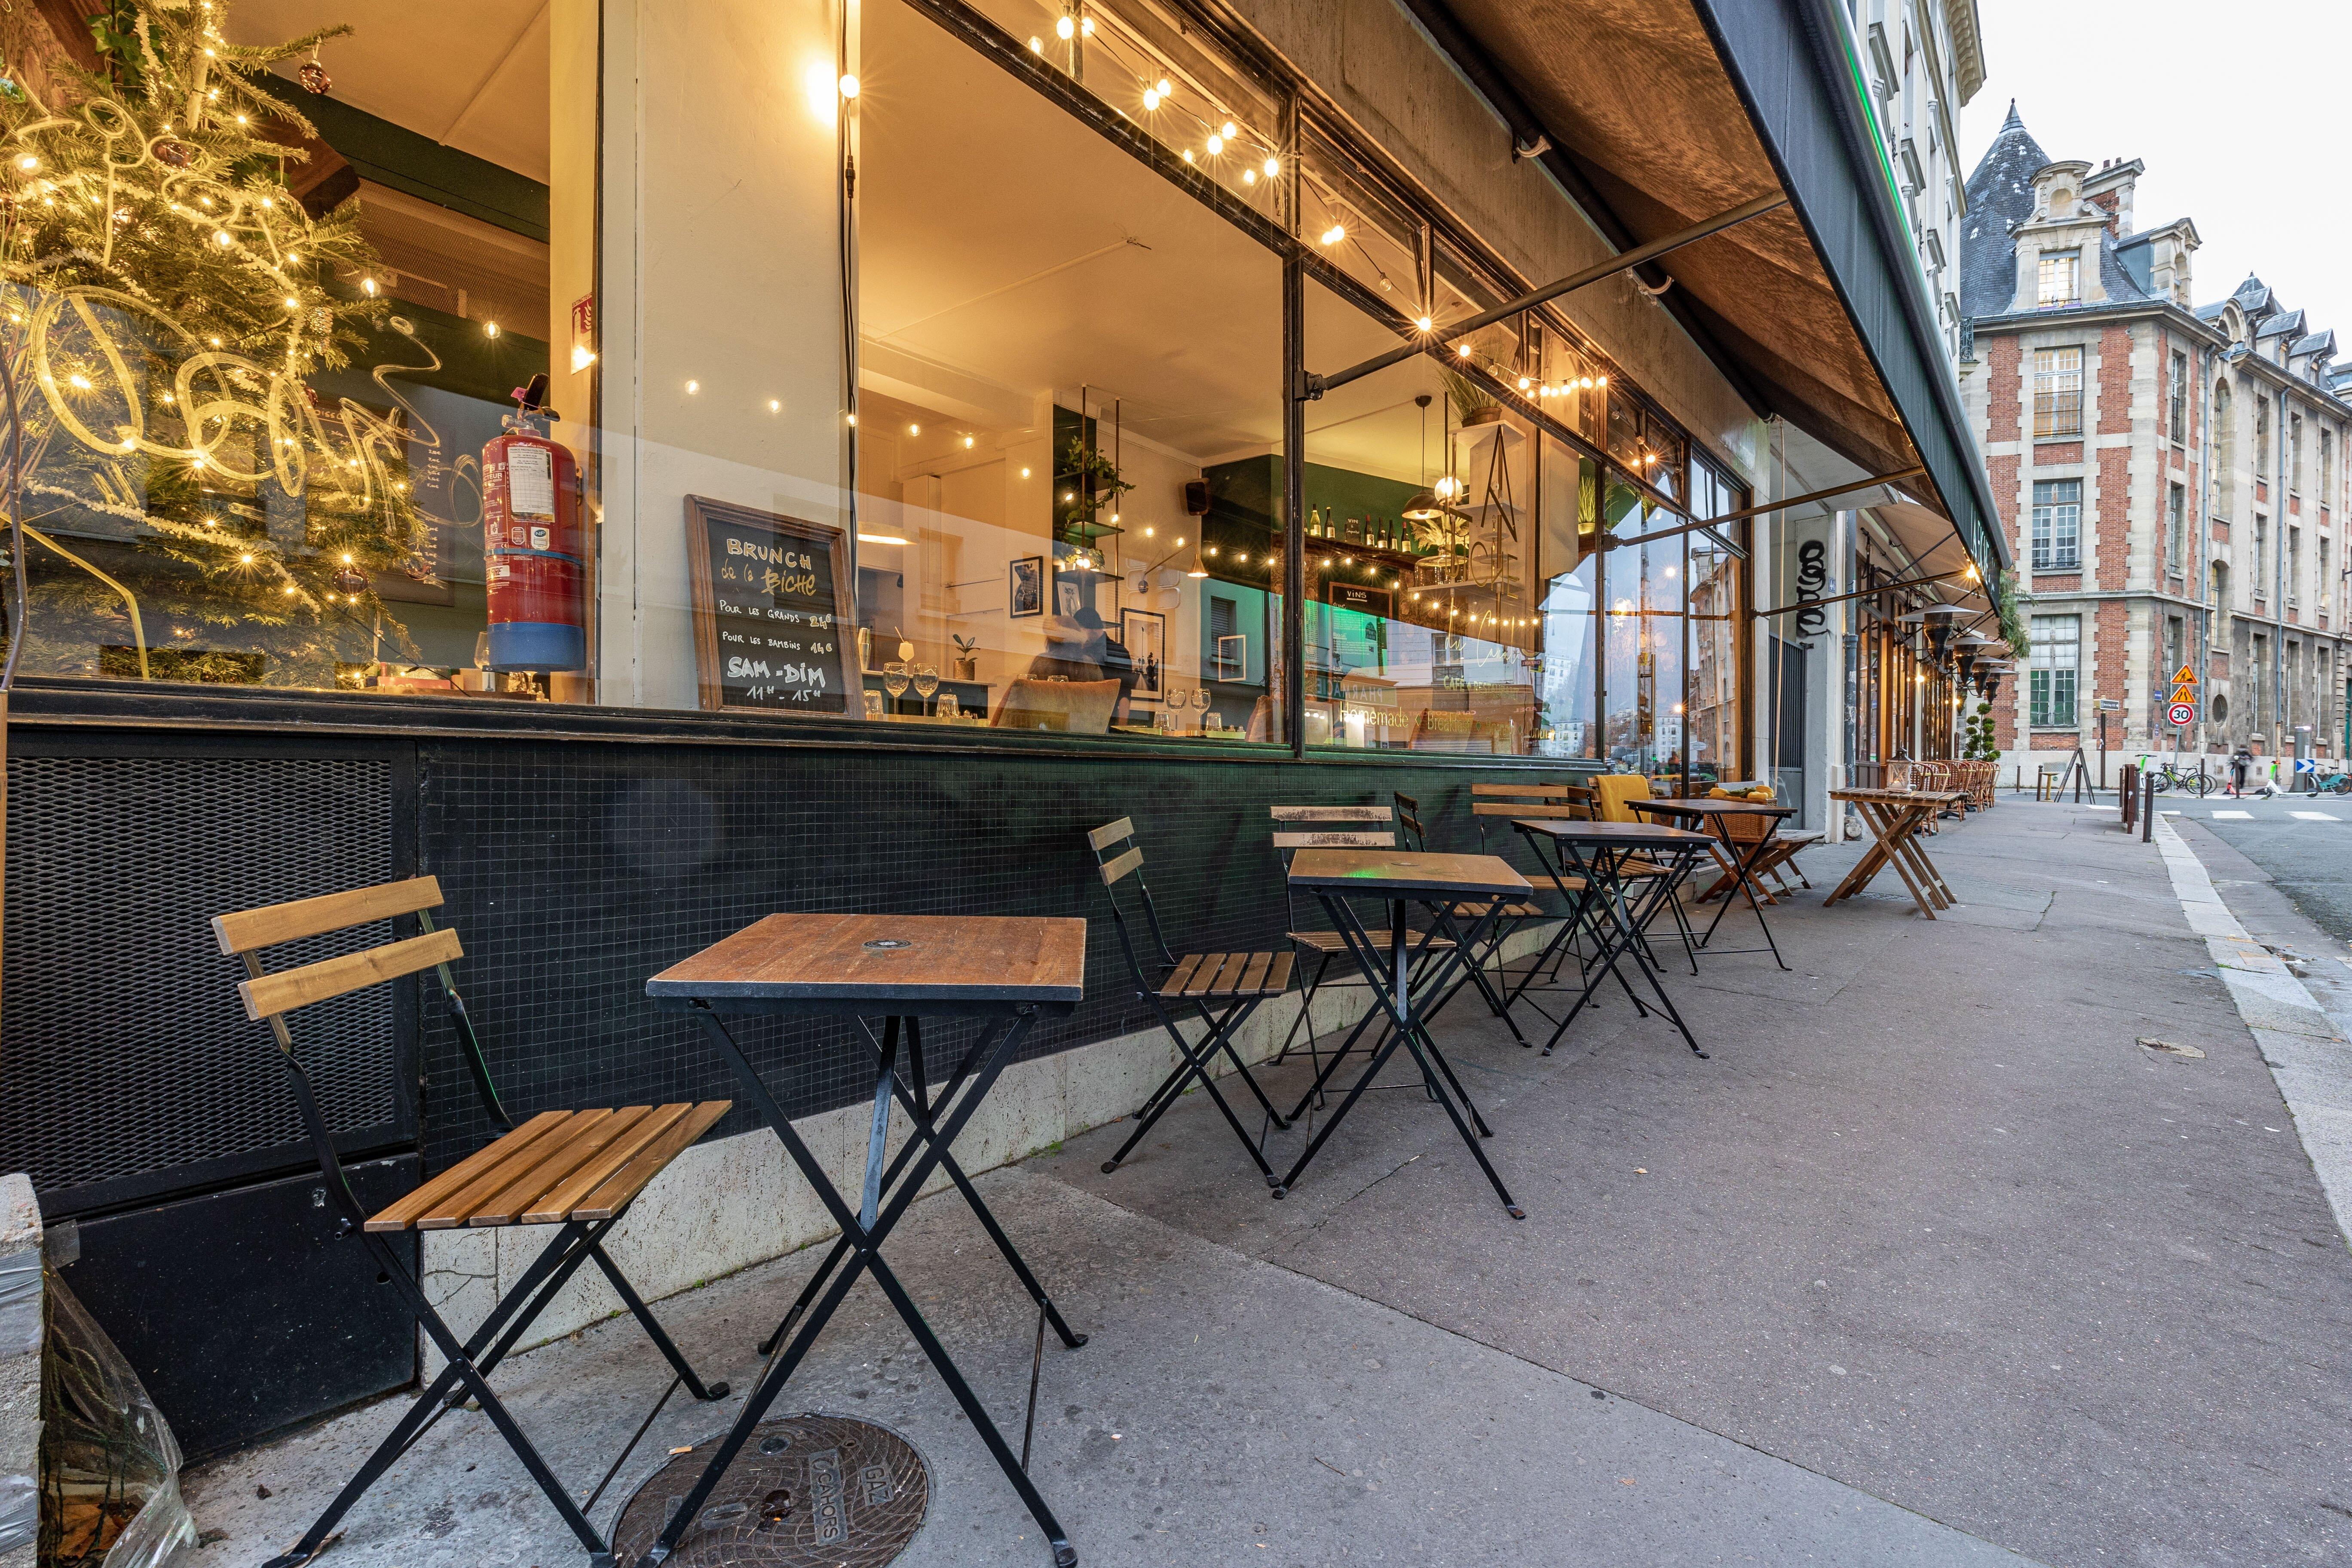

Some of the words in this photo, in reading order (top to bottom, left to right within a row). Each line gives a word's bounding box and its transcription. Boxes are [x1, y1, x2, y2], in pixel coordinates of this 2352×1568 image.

[726, 538, 812, 570] BRUNCH
[721, 558, 736, 580] de
[744, 563, 754, 582] la
[748, 607, 760, 616] LES
[767, 609, 800, 624] GRANDS
[750, 636, 761, 645] LES
[727, 656, 771, 679] SAM
[2173, 710, 2189, 720] 30
[866, 1467, 890, 1504] GAZ
[817, 1473, 839, 1540] CAHORS
